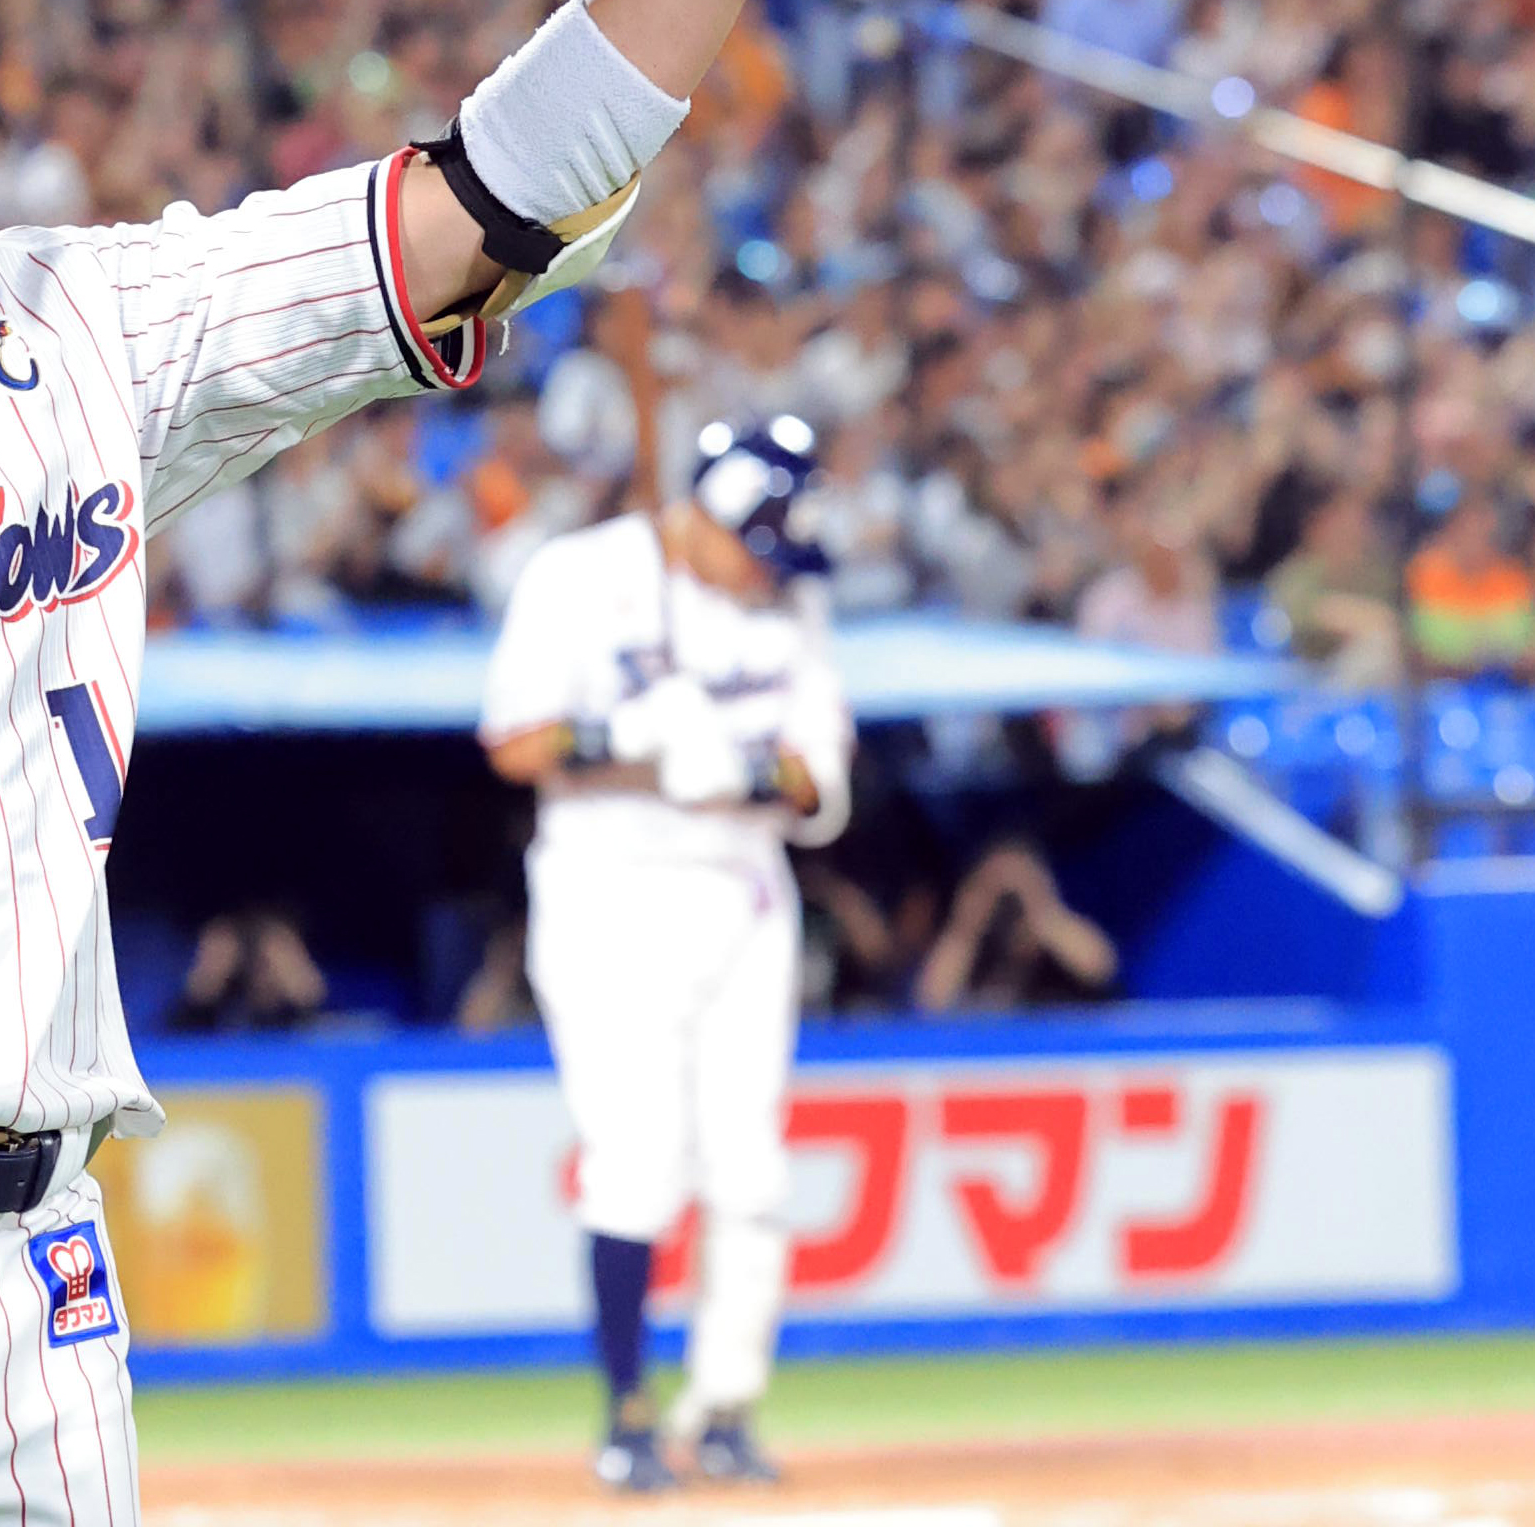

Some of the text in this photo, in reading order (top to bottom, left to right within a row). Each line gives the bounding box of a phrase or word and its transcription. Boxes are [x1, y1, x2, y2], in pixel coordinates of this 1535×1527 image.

[561, 1085, 1266, 1299] フマン
[55, 1301, 107, 1332] タフマン
